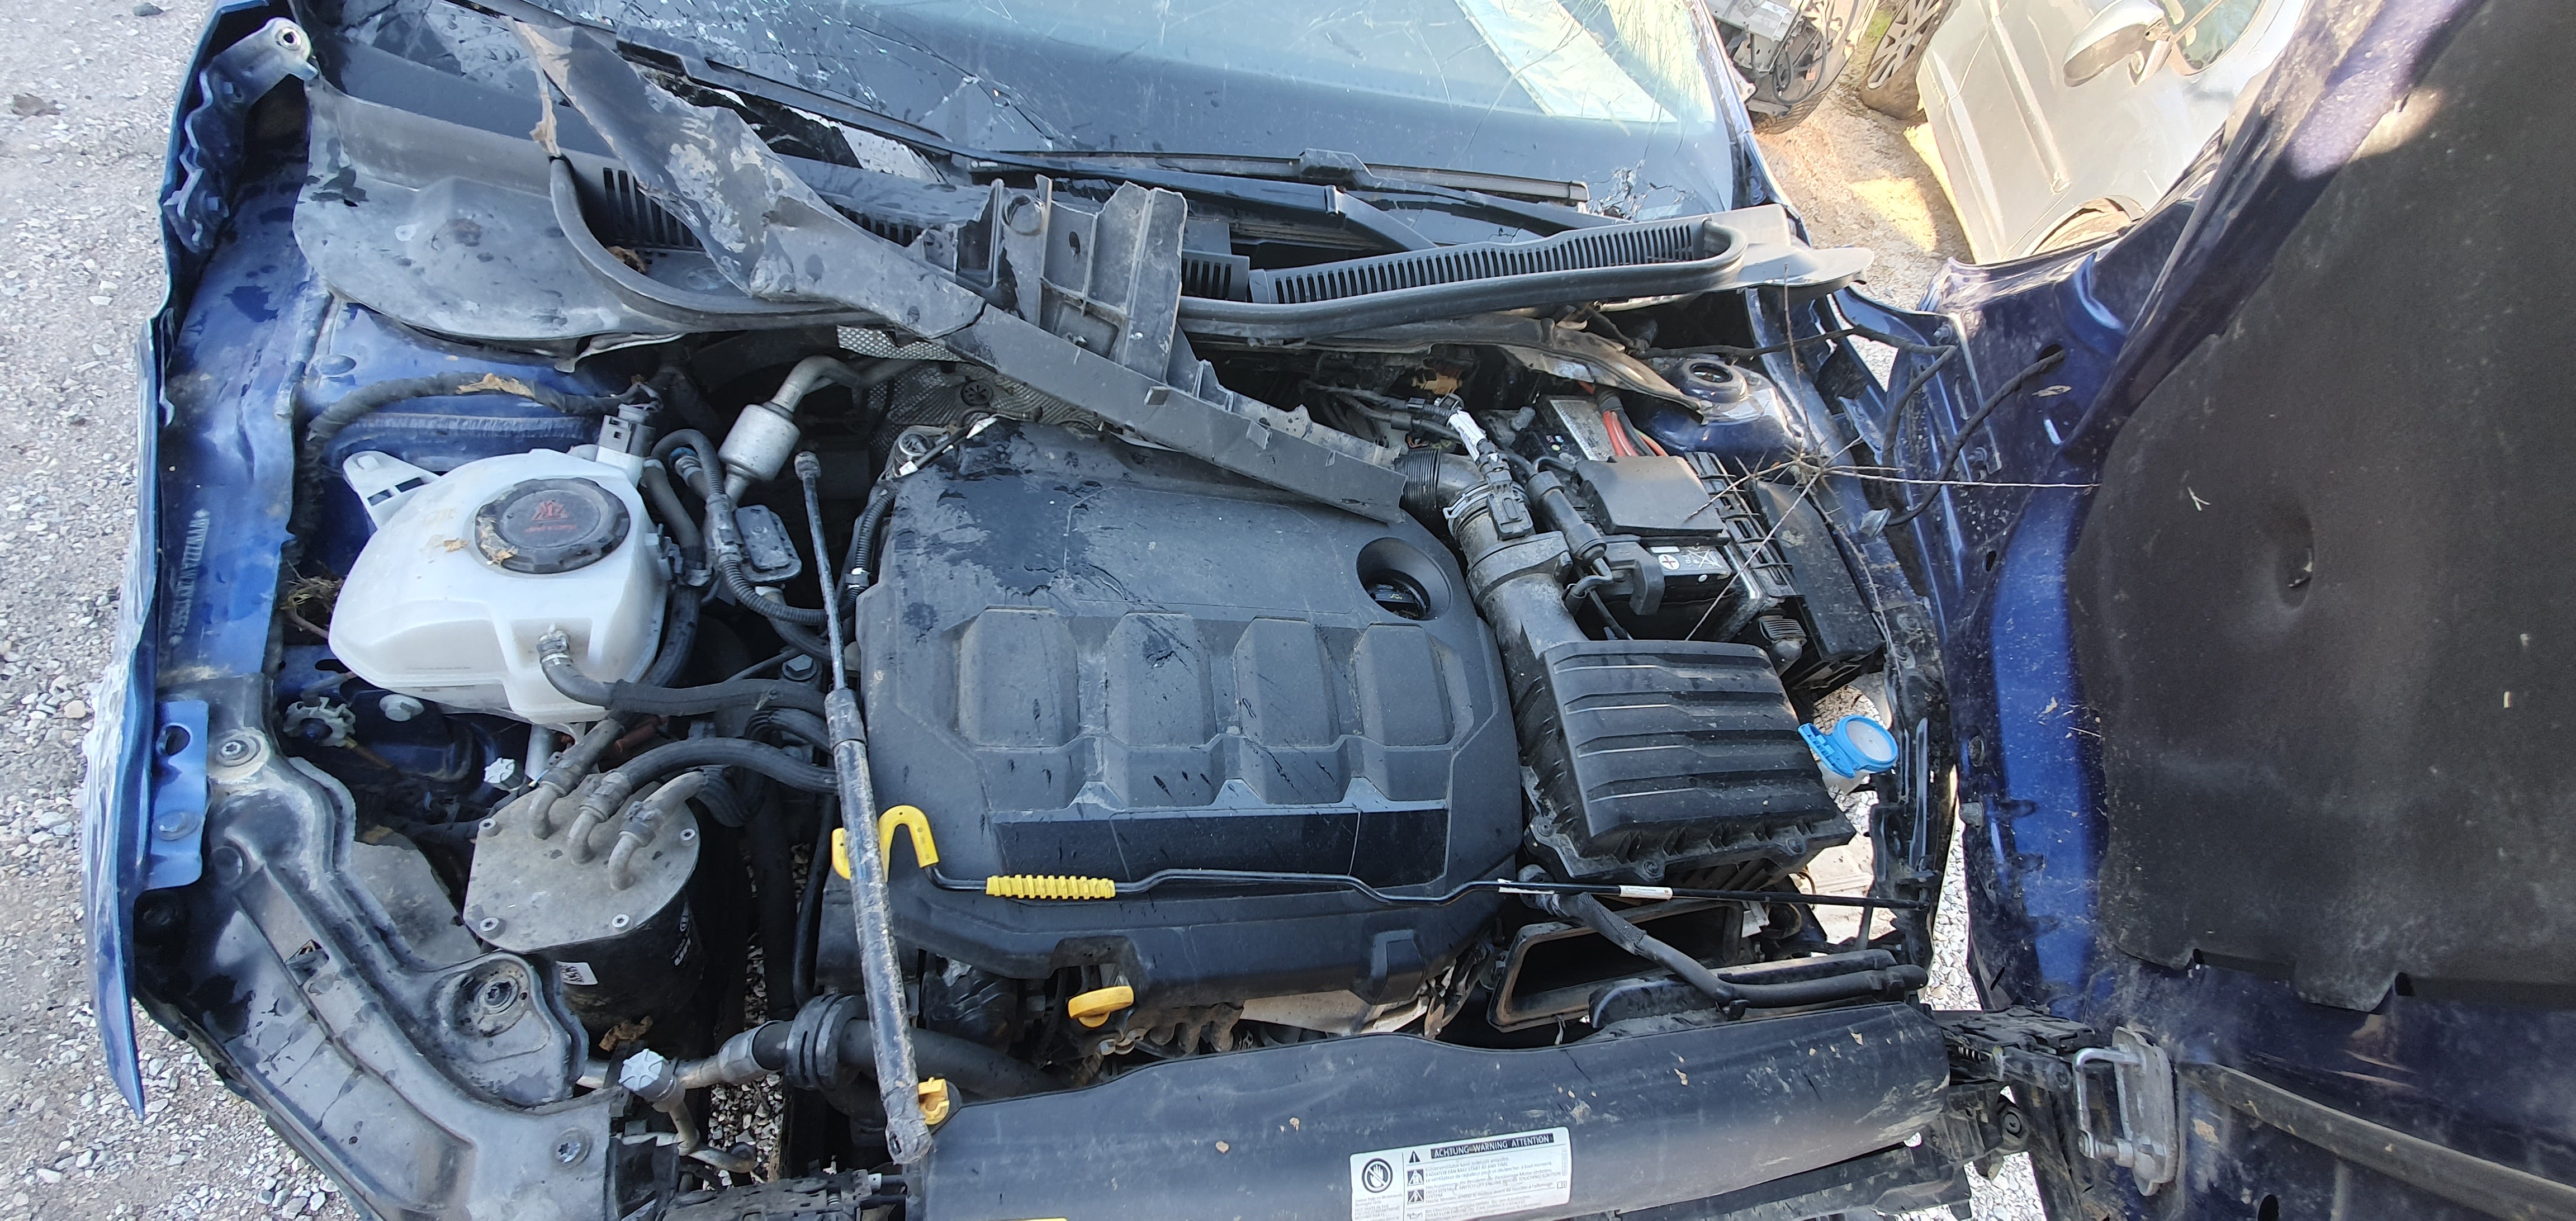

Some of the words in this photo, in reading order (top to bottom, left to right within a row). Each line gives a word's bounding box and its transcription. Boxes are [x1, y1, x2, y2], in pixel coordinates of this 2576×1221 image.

[1434, 1146, 1469, 1157] ACHTUNG
[1473, 1140, 1507, 1152] WARNING
[1512, 1135, 1549, 1147] ATTENTION
